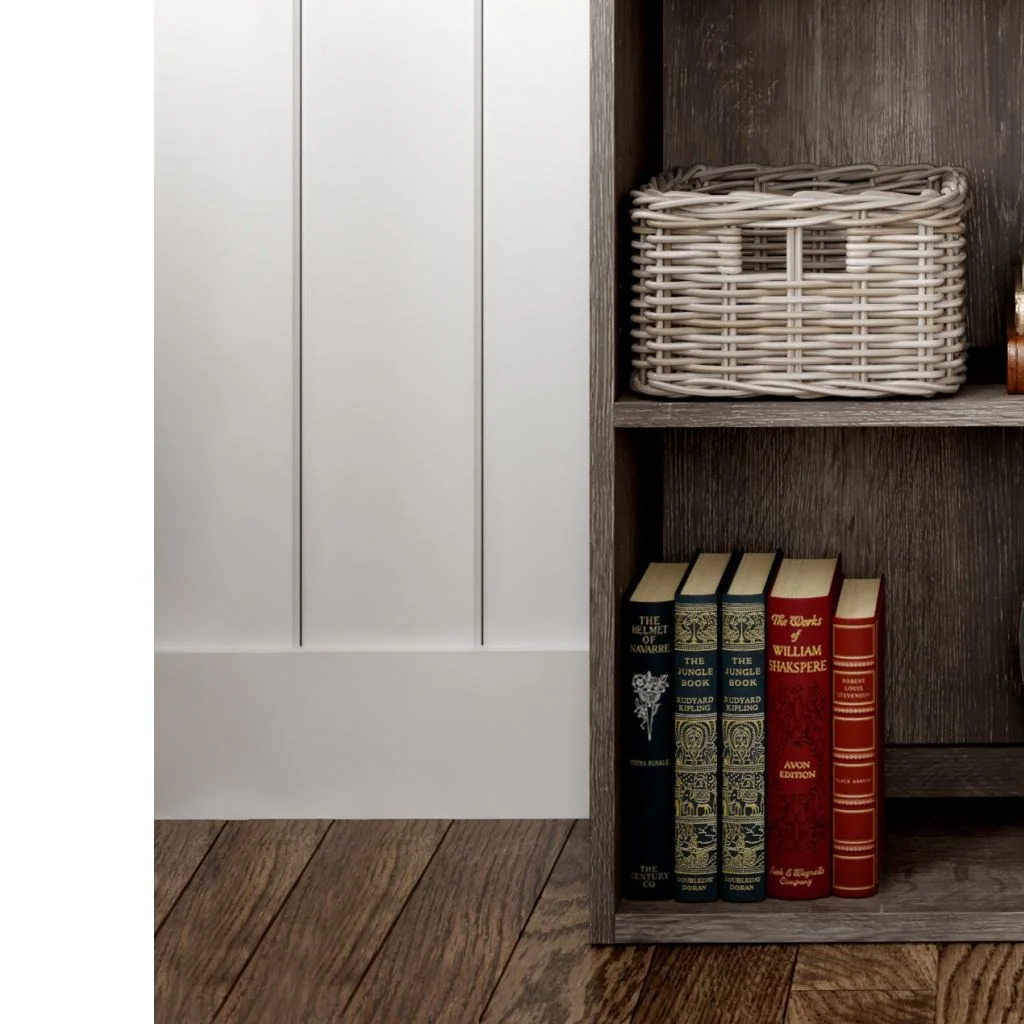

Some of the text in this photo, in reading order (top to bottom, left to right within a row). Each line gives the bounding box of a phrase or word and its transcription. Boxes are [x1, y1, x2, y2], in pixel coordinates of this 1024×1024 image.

[638, 615, 661, 625] THE
[771, 613, 823, 627] The Works
[631, 624, 669, 635] HELMET
[641, 635, 657, 645] OF
[790, 629, 803, 643] of
[629, 644, 671, 654] NAVARRE
[772, 643, 822, 657] WILLIAM
[684, 657, 706, 665] THE
[731, 657, 753, 665] THE
[768, 658, 828, 673] SHAKSPERE
[677, 667, 715, 676] JUNGLE
[724, 667, 762, 676] JUNGLE
[681, 679, 711, 687] BOOK
[728, 679, 758, 687] BOOK
[676, 696, 714, 705] RUDYARD
[724, 696, 763, 705] RUDYARD
[678, 704, 712, 712] KIPLING
[726, 704, 760, 712] KIPLING
[784, 760, 811, 769] AVON
[779, 769, 817, 779] EDITION
[639, 864, 659, 873] THE
[629, 871, 670, 881] CENTURY
[682, 884, 708, 892] DORAN
[729, 884, 755, 892] DORAN
